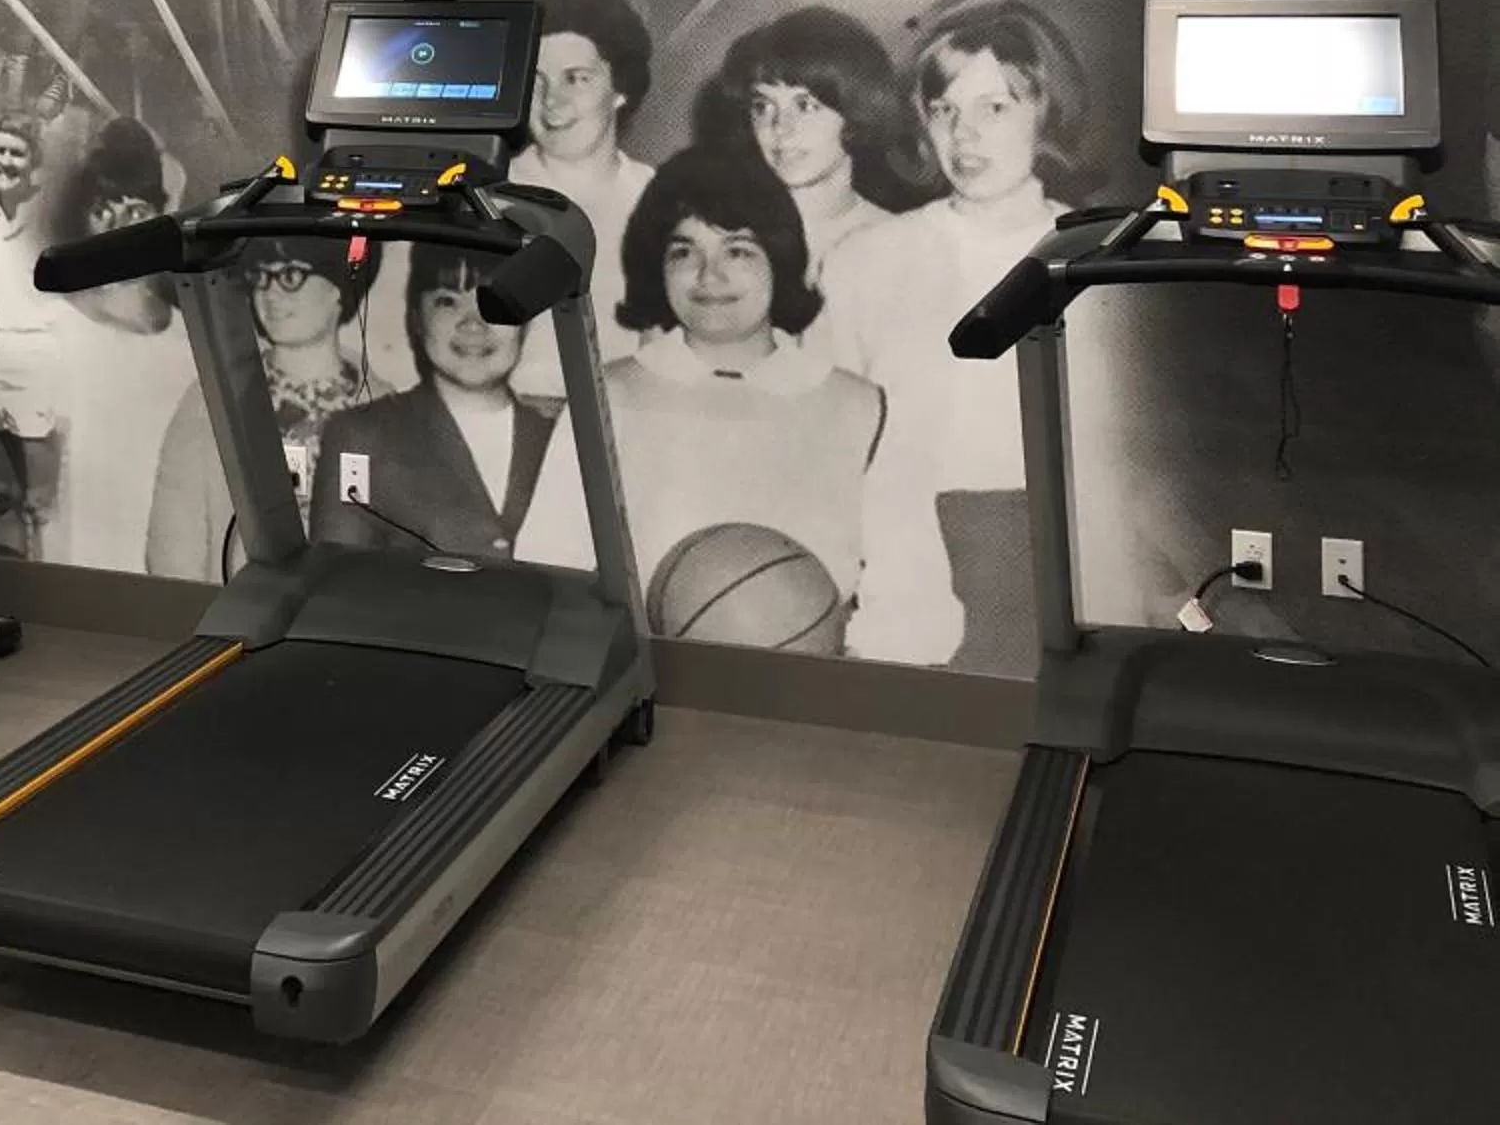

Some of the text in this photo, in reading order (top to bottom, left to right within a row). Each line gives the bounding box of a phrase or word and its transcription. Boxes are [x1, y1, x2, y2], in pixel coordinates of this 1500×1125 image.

[380, 115, 438, 125] MATRIX
[1248, 133, 1326, 146] MATRIX
[381, 753, 438, 801] MATRIX
[1456, 865, 1484, 926] MATRIX
[1052, 1013, 1088, 1092] MATRIX
